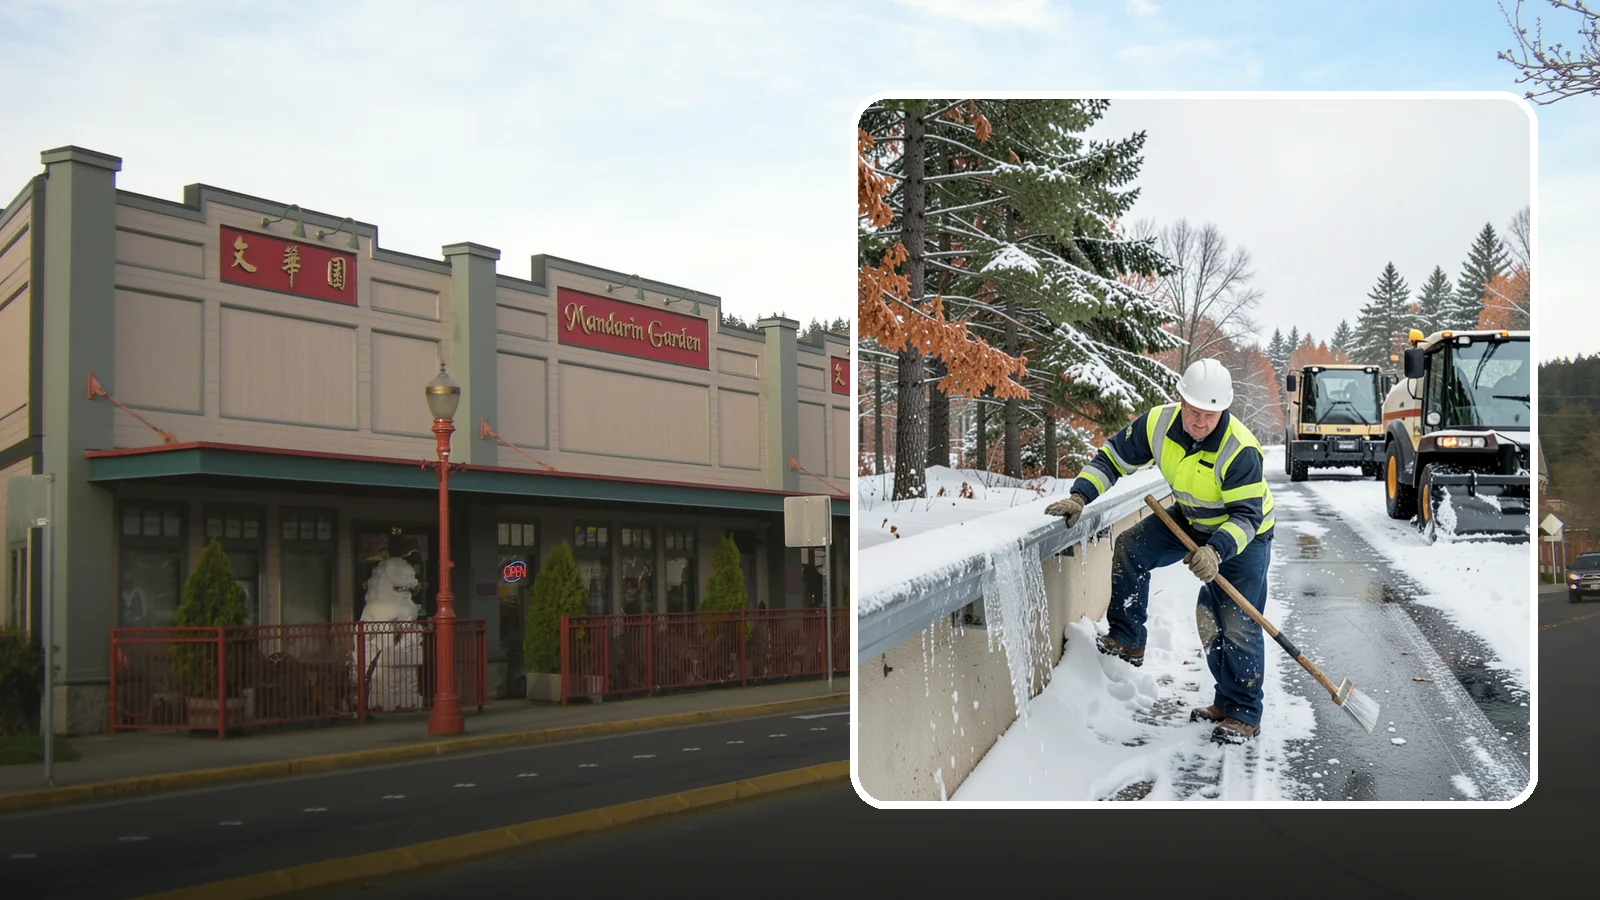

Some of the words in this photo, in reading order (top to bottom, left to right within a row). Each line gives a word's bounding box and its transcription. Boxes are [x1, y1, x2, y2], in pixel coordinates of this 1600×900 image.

[564, 302, 644, 341] Mandarin
[647, 320, 701, 352] Garden
[503, 565, 527, 578] OPEN
